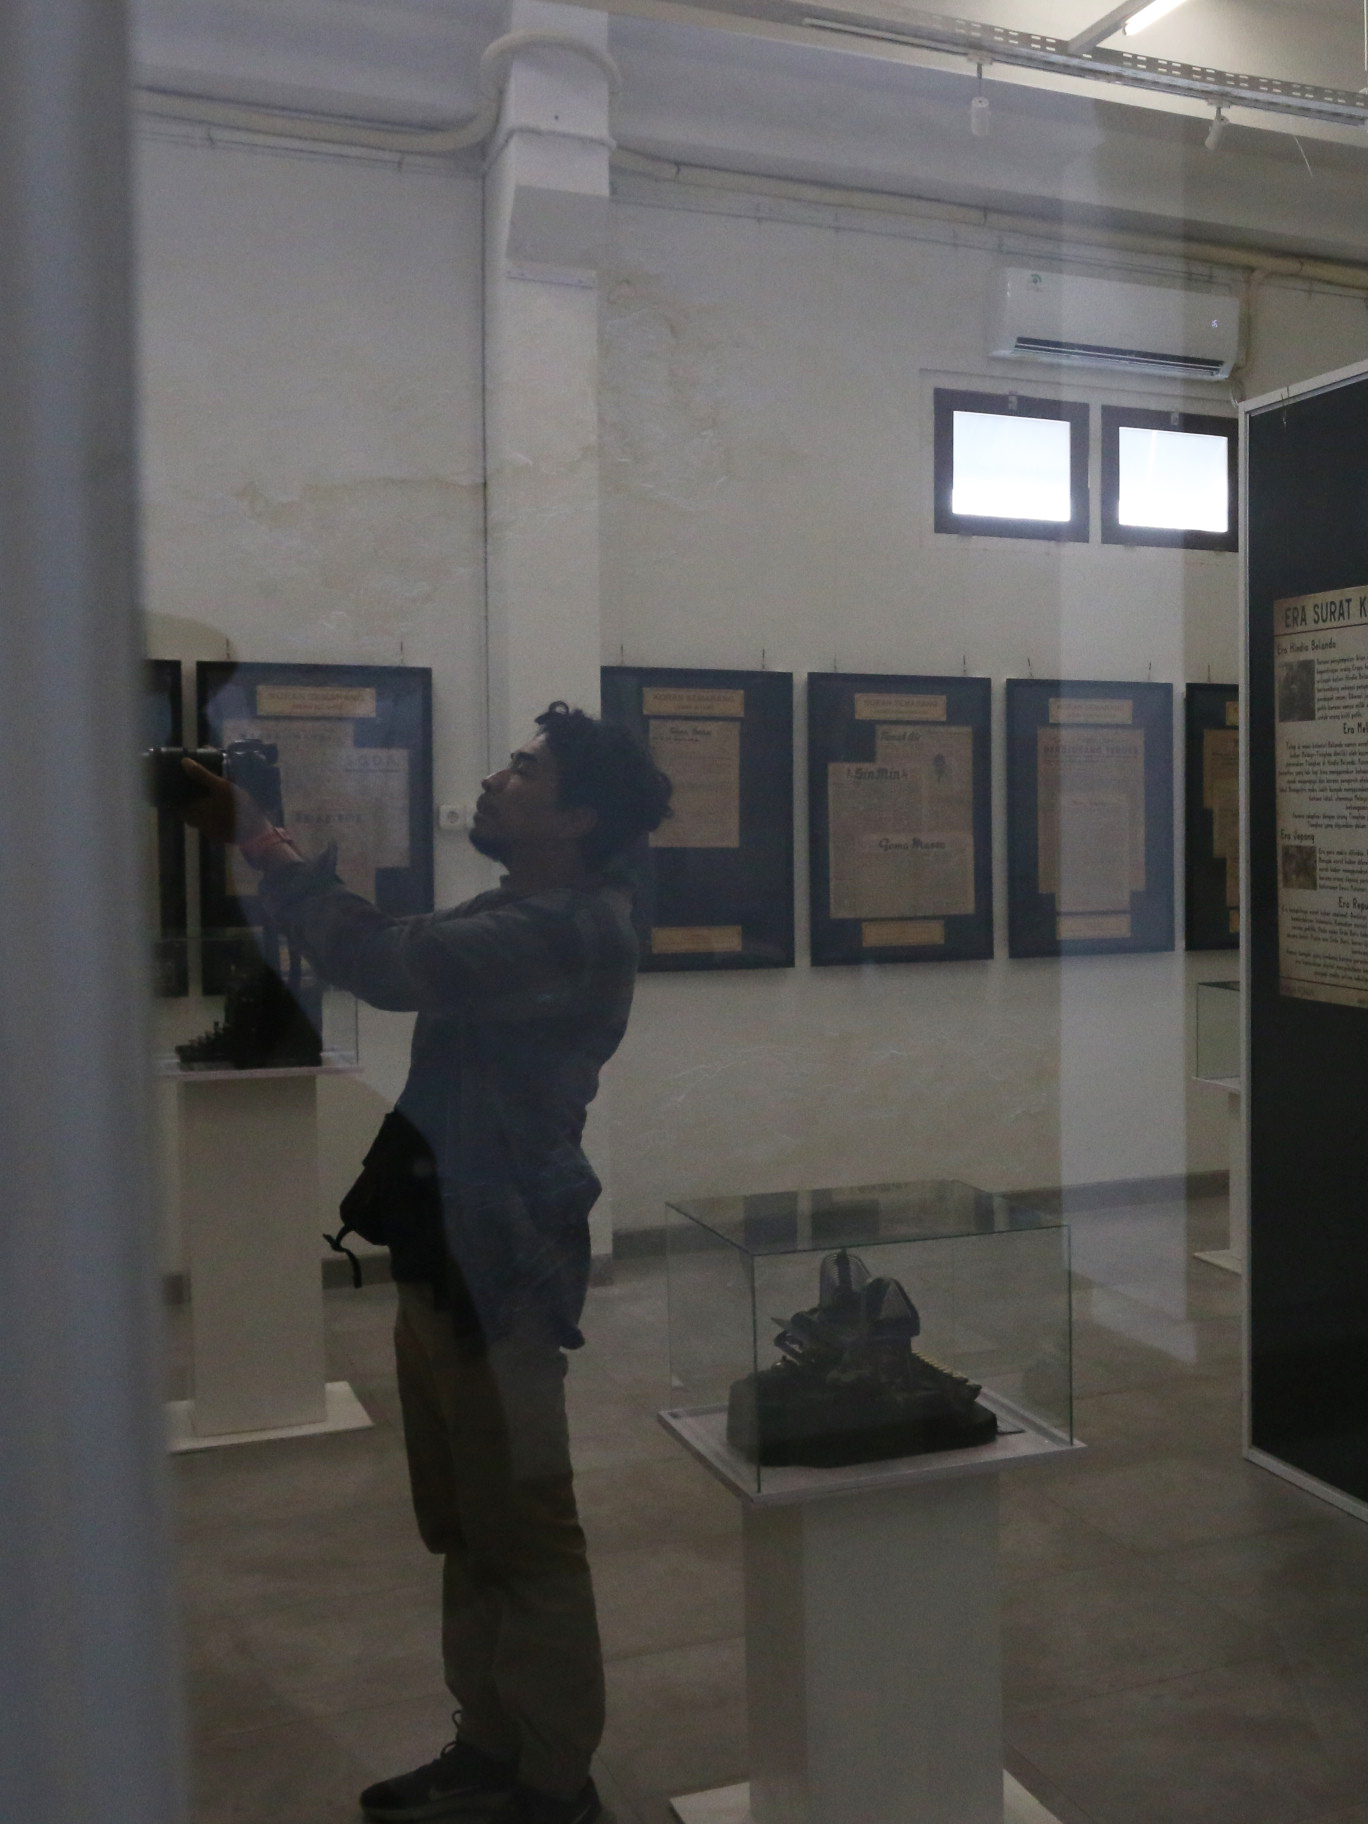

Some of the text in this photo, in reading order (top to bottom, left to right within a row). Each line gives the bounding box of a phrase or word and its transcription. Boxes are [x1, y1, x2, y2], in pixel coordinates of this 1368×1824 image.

[1284, 606, 1307, 628] ERA
[1313, 598, 1352, 623] SURAT
[1277, 638, 1336, 655] Era Hindia Belanda
[1343, 722, 1355, 735] Era
[1280, 829, 1315, 844] Era Jepang
[1338, 896, 1350, 908] Era
